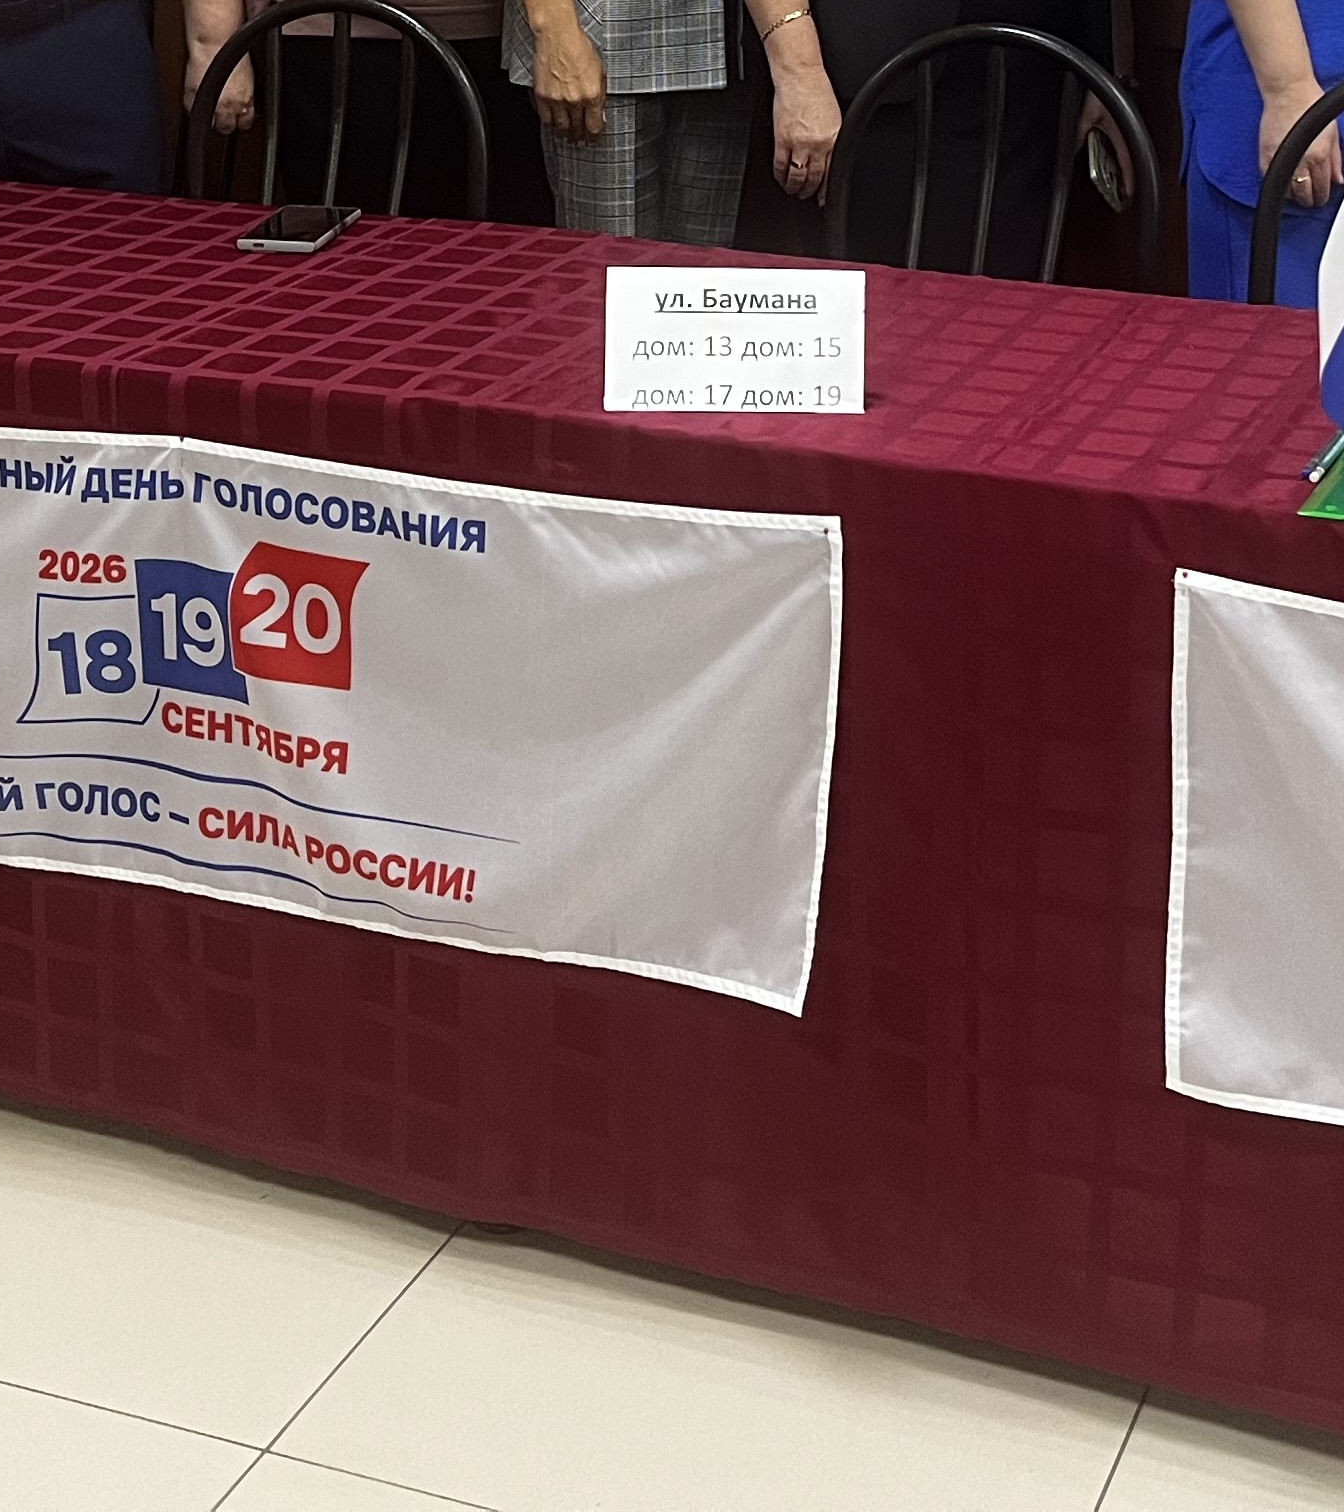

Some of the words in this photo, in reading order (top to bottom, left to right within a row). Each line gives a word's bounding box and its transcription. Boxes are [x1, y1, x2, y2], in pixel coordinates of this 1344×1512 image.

[655, 292, 692, 312] ул.
[702, 288, 817, 312] Баумана
[632, 340, 694, 360] дом:
[704, 336, 732, 357] 13
[741, 340, 803, 361] дом:
[814, 337, 841, 358] 15
[632, 389, 694, 408] дом:
[704, 385, 732, 406] 17
[741, 389, 803, 408] дом:
[814, 386, 841, 406] 19
[81, 464, 185, 504] ДЕНЬ
[192, 471, 487, 553] ГОЛОСОВАНИЯ
[38, 549, 127, 583] 2026
[47, 630, 136, 694] 18
[150, 593, 226, 667] 19
[239, 572, 343, 655] 20
[161, 701, 349, 774] СЕНТЯБРЯ
[35, 781, 162, 821] ГОЛОС
[197, 806, 300, 857] СИЛА
[304, 833, 477, 903] РОССИИ!
